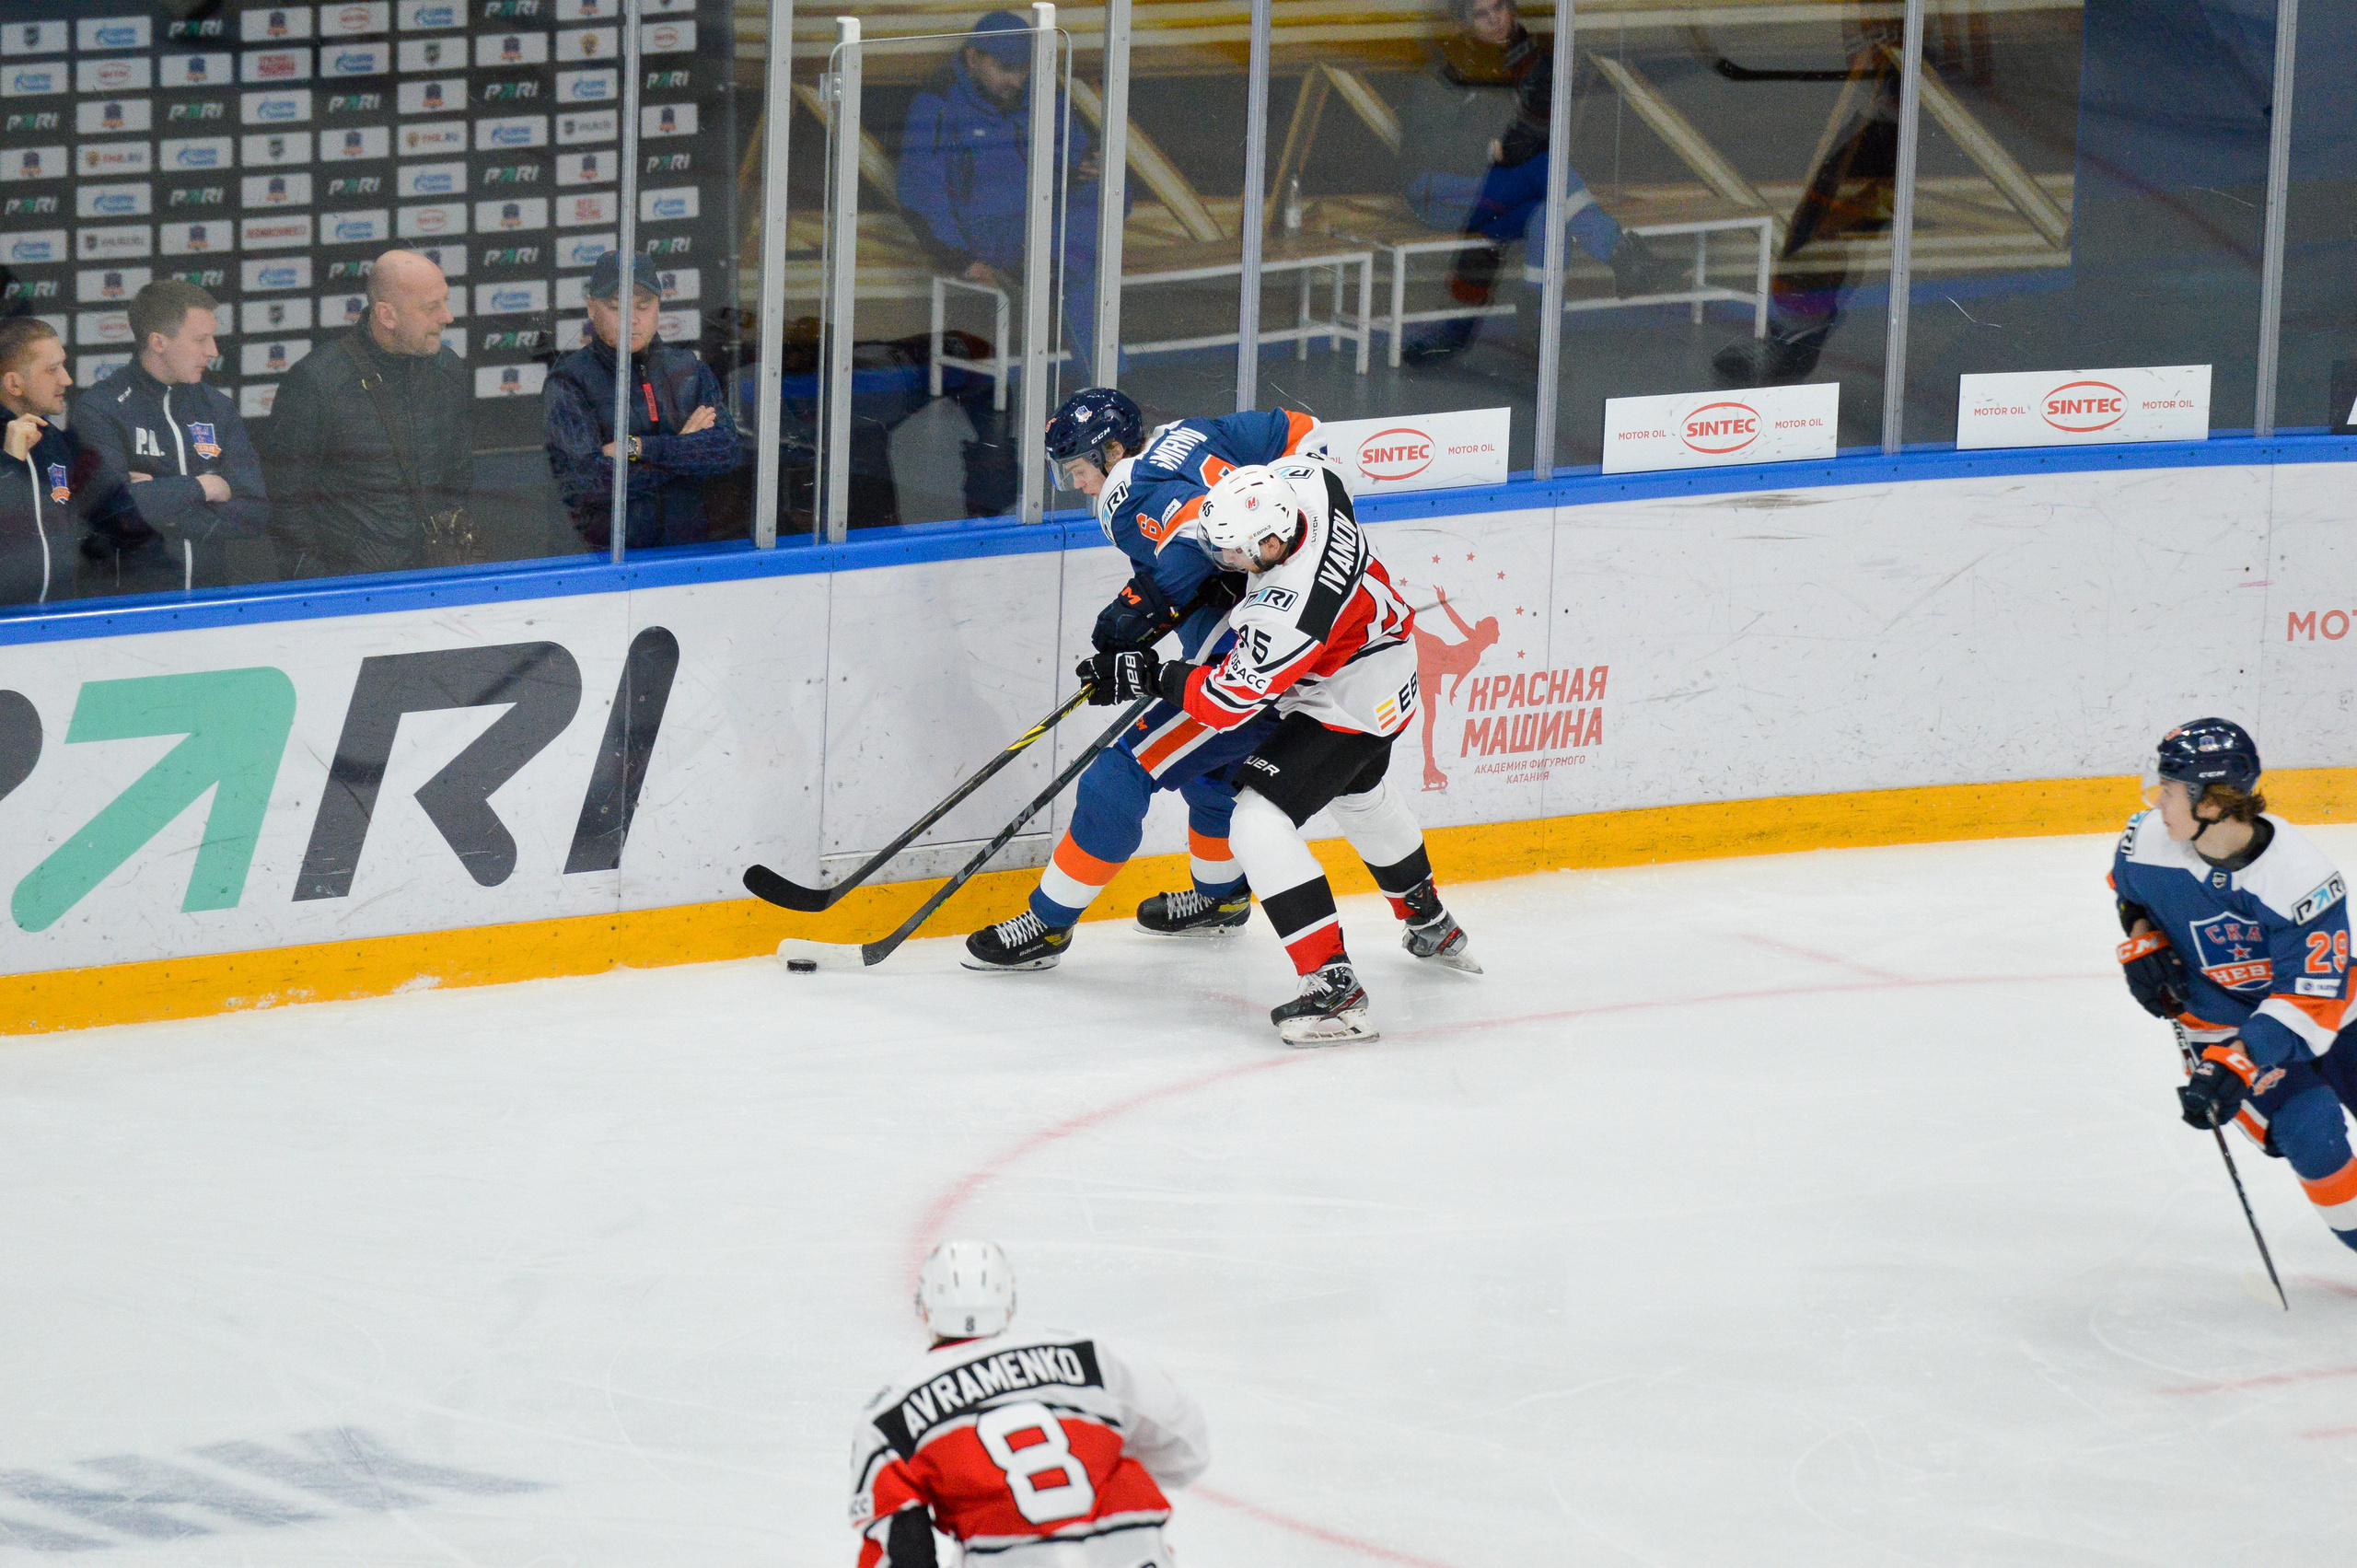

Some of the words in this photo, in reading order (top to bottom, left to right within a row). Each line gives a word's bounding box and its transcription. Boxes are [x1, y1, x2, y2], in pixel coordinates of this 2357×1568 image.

[330, 261, 374, 279] PAR
[1974, 407, 2008, 416] MOTOR
[2010, 406, 2026, 415] OIL
[2047, 398, 2121, 415] SINTEC
[2142, 401, 2176, 410] MOTOR
[2178, 400, 2194, 408] OIL
[1687, 418, 1756, 437] SINTEC
[1774, 419, 1806, 429] MOTOR
[1808, 418, 1823, 427] OIL
[1091, 426, 1110, 445] CCM
[1618, 431, 1650, 440] MOTOR
[1653, 430, 1666, 438] OIL
[1362, 444, 1430, 464] SINTEC
[1448, 445, 1479, 455] MOTOR
[1480, 444, 1495, 452] OIL
[1136, 513, 1162, 541] 6
[1253, 525, 1271, 538] ЕВРАЗ
[1318, 508, 1357, 595] IVANOV
[1239, 624, 1271, 665] 45
[1468, 666, 1608, 713] КРАСНАЯ
[1460, 707, 1603, 758] МАШИНА
[1474, 759, 1527, 775] АКАДЕМИЯ
[1529, 755, 1585, 769] ФИГУРНОГО
[0, 626, 679, 933] ARI
[1506, 772, 1550, 784] КАТАНИЯ
[2205, 923, 2262, 945] СКА
[2305, 930, 2349, 973] 29
[2210, 964, 2272, 984] НЕВ
[966, 1316, 974, 1331] 8
[902, 1346, 1086, 1439] AVRAMENKO
[976, 1400, 1096, 1526] 8
